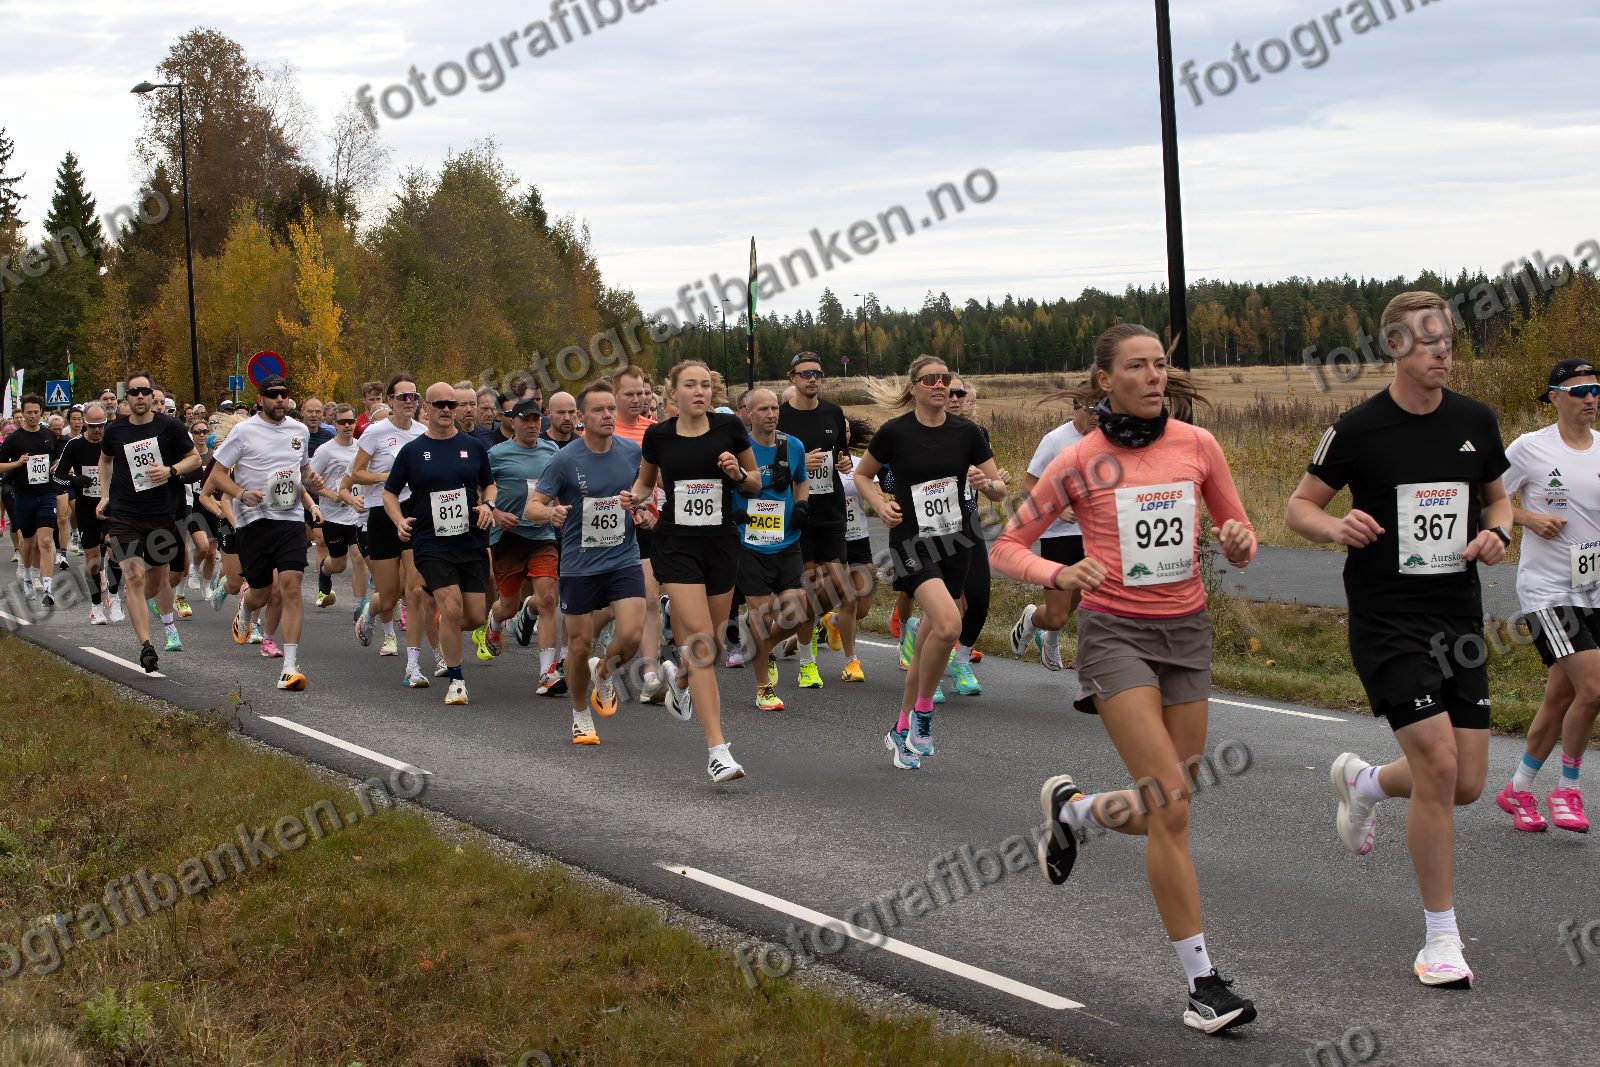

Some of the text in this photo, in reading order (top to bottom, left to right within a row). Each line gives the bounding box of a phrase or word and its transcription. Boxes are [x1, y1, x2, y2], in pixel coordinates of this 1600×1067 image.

[134, 452, 155, 467] 383
[32, 463, 47, 473] 400
[275, 481, 294, 495] 428
[1415, 488, 1458, 499] NORGES
[1136, 490, 1183, 503] NORGES
[1419, 498, 1452, 507] LØPET
[440, 504, 463, 520] 812
[684, 499, 714, 517] 496
[924, 496, 951, 517] 801
[1140, 500, 1177, 512] LØPET
[591, 513, 618, 530] 463
[750, 515, 780, 528] PACE
[1413, 513, 1458, 541] 367
[1135, 517, 1184, 549] 923
